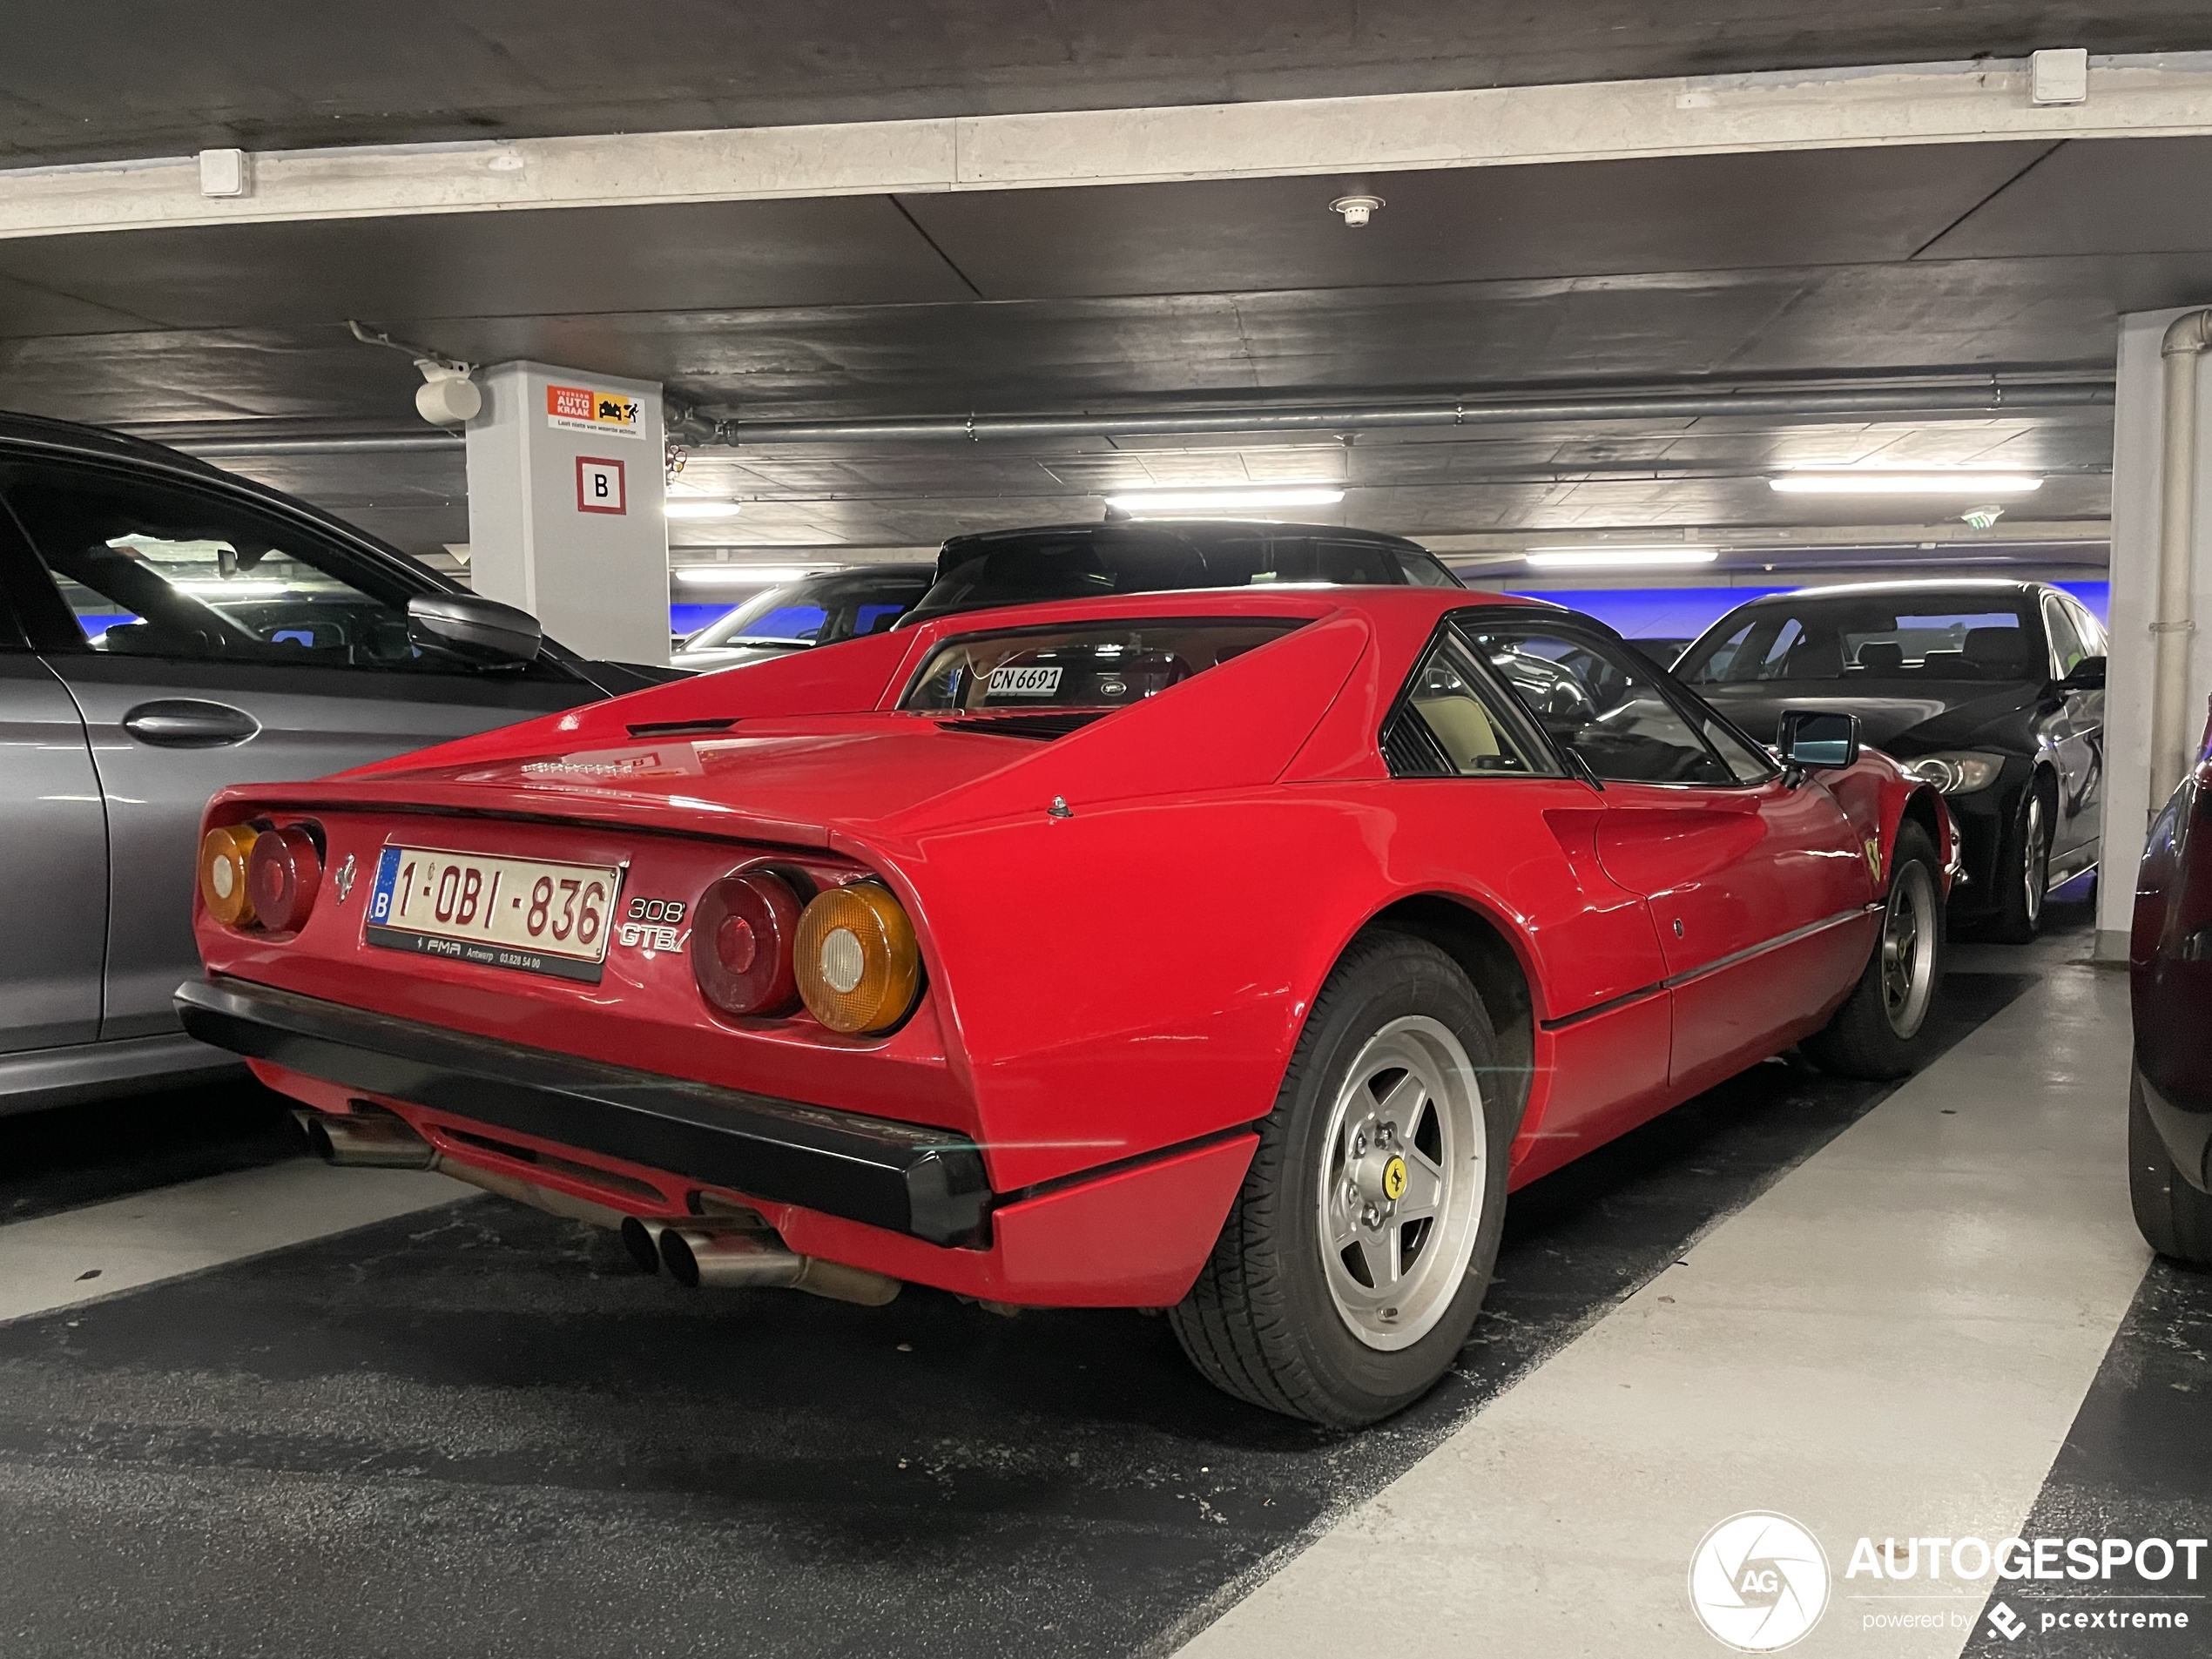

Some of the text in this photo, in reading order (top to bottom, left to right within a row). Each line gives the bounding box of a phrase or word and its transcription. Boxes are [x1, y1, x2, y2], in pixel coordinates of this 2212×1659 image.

[557, 396, 590, 409] AUTO
[557, 405, 590, 417] KRAAK
[595, 474, 609, 497] B
[990, 670, 1059, 690] CN 6691
[374, 893, 388, 918] B
[628, 898, 685, 923] 308
[466, 948, 494, 962] Antwerp
[522, 957, 531, 968] 54
[531, 959, 541, 968] 00
